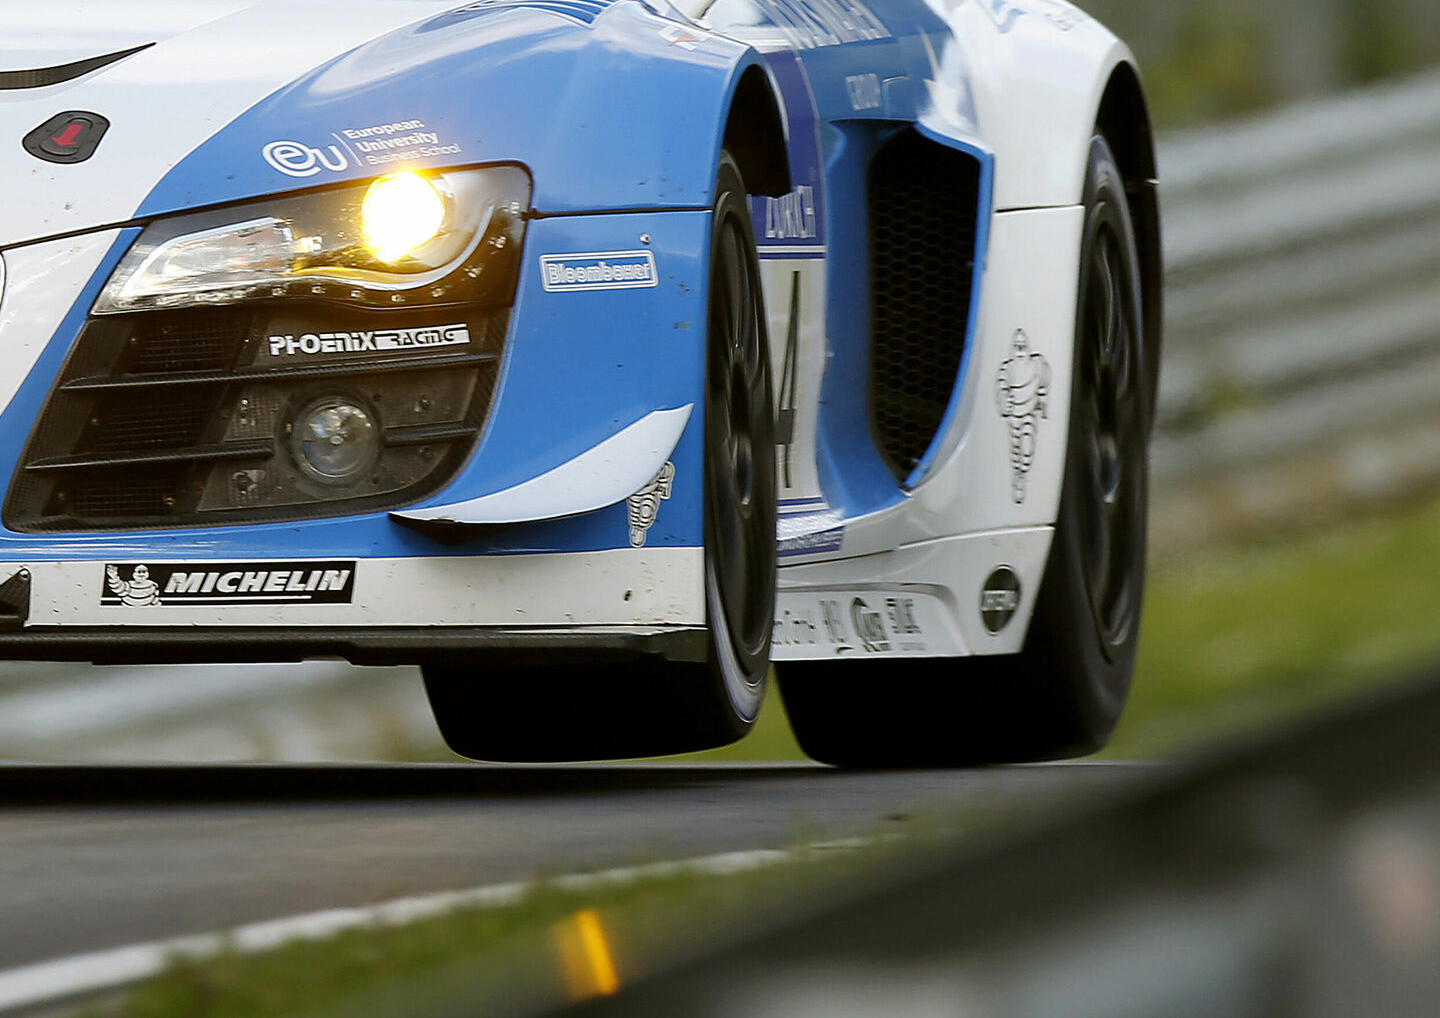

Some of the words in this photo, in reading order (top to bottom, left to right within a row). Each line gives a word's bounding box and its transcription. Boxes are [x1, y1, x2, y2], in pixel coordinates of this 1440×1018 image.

[342, 119, 426, 140] European
[355, 131, 440, 153] University
[366, 151, 420, 165] Business
[420, 143, 462, 157] School
[163, 569, 351, 594] MICHELIN
